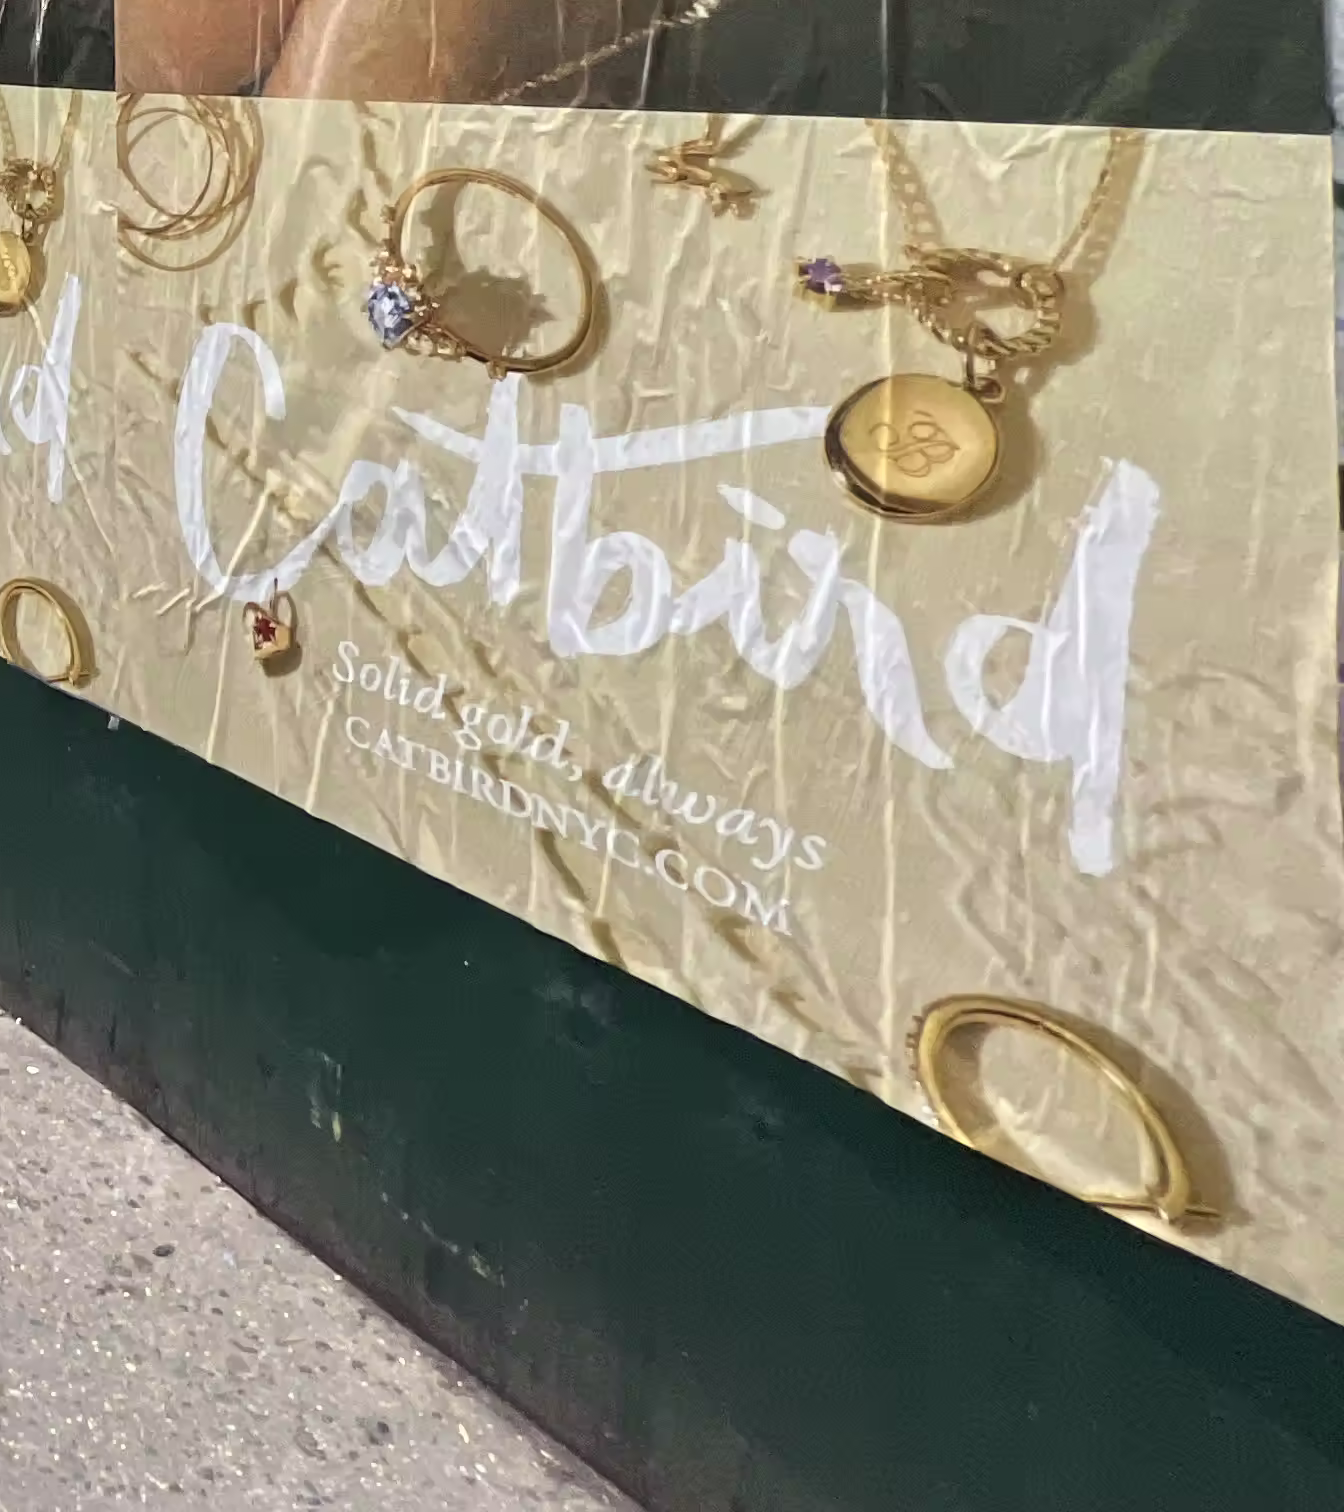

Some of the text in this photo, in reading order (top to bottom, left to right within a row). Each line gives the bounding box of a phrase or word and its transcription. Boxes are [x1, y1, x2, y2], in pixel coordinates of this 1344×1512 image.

[174, 321, 1161, 877] Catbird
[332, 640, 828, 872] Solid gold, always
[344, 715, 793, 937] CATBIRDNYC.COM
